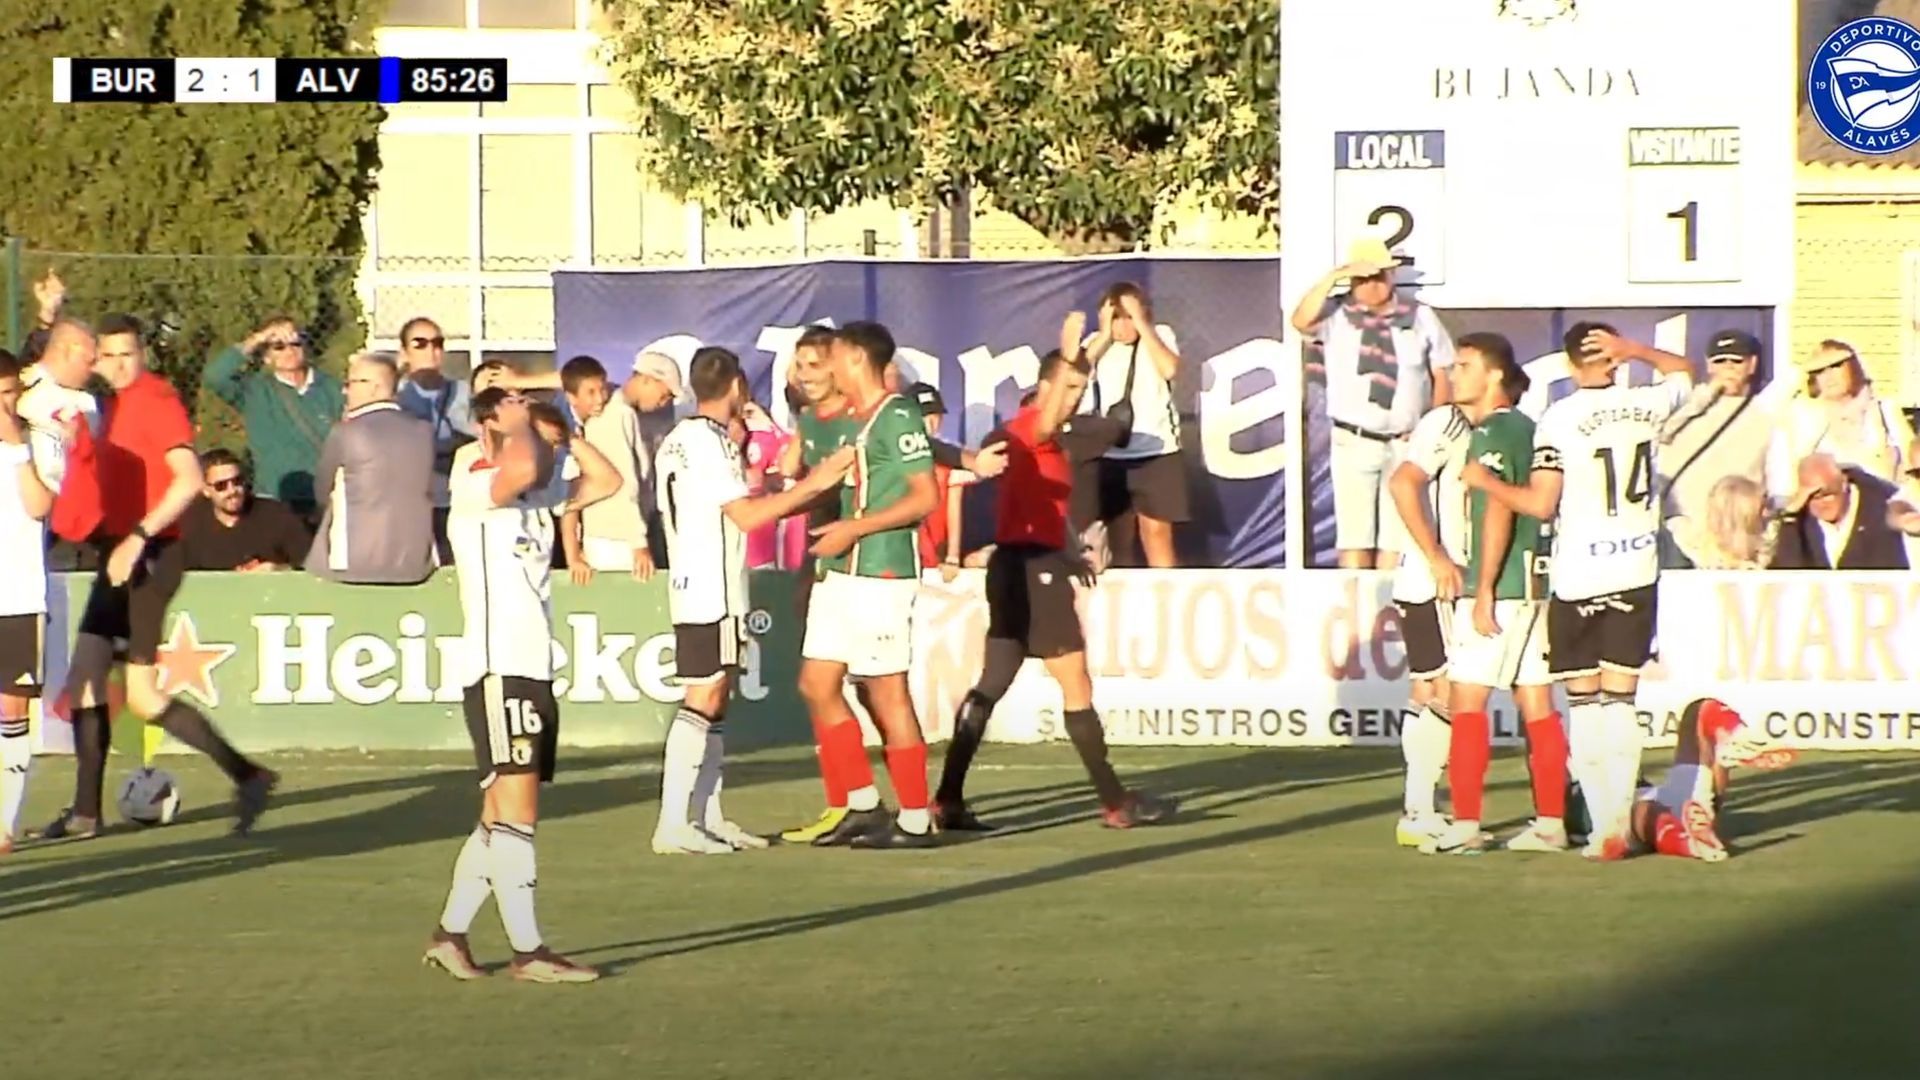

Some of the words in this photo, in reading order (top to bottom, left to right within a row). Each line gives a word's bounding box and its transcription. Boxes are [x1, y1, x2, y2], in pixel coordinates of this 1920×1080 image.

[1347, 134, 1433, 169] LOCAL
[1630, 128, 1740, 164] VISITANTE
[1366, 204, 1415, 266] 2
[1667, 200, 1699, 262] 1
[1592, 439, 1653, 517] 14
[1590, 530, 1659, 557] DIG
[250, 612, 768, 705] Heike
[1323, 576, 1410, 681] de
[505, 697, 543, 736] 16
